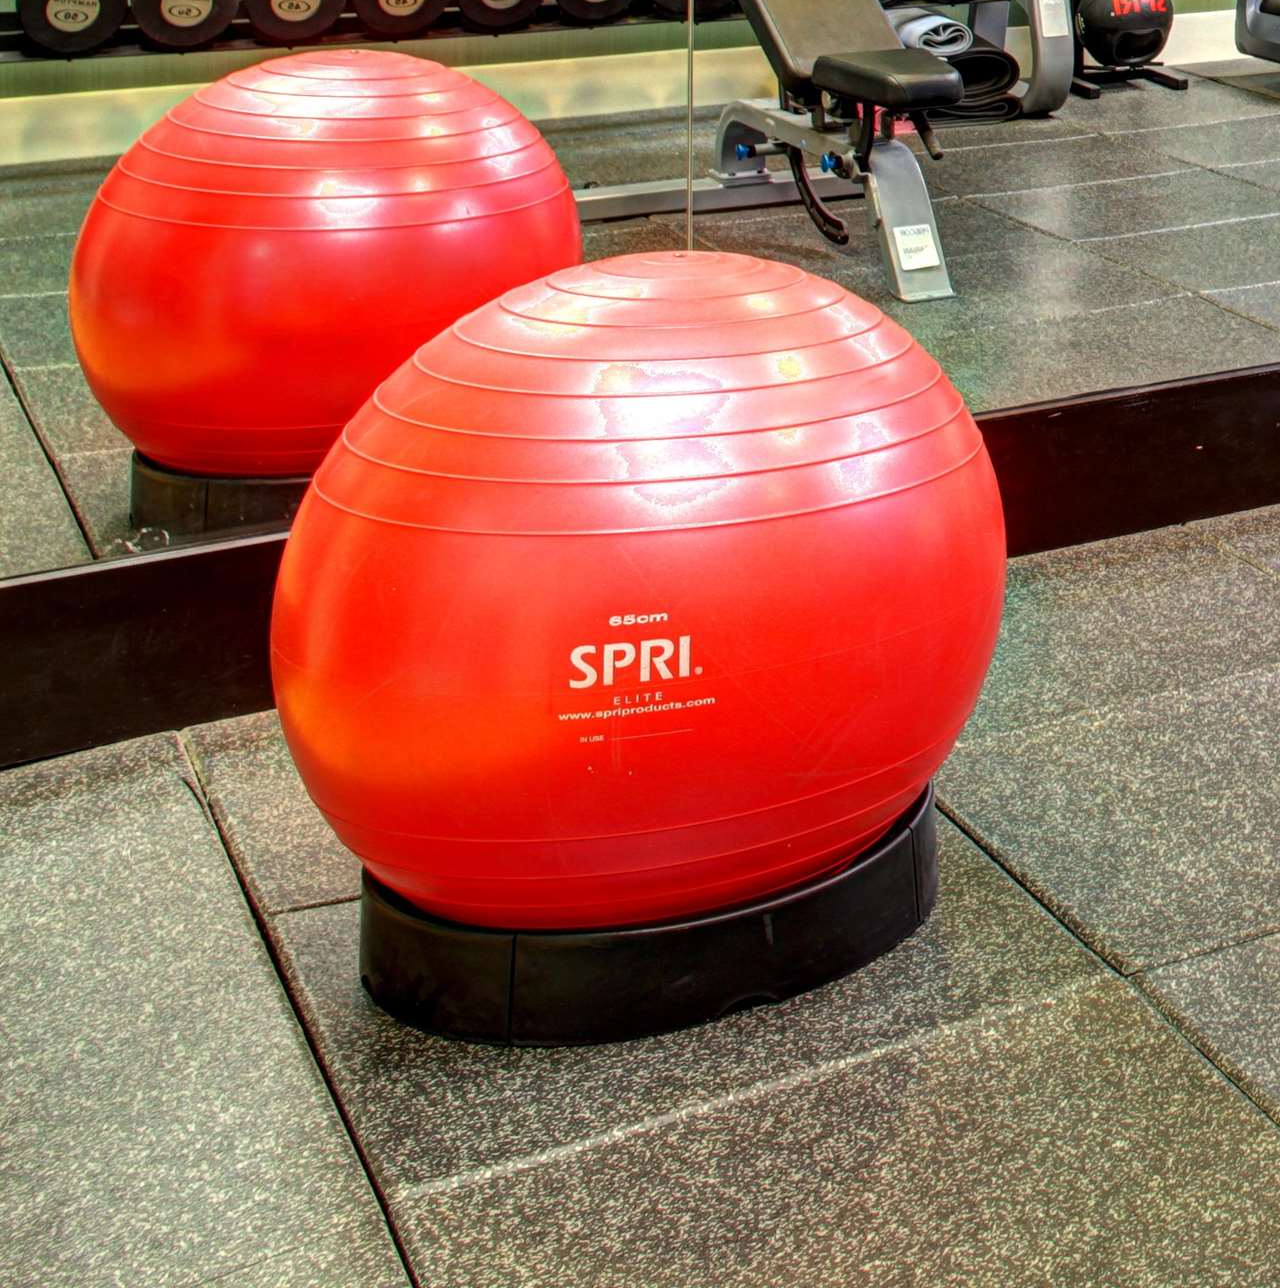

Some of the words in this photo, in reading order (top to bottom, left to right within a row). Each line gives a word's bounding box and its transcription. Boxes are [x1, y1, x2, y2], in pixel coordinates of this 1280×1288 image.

[608, 612, 669, 627] 65cm
[613, 691, 664, 706] ELITE
[558, 696, 717, 721] www.spriproducts.com
